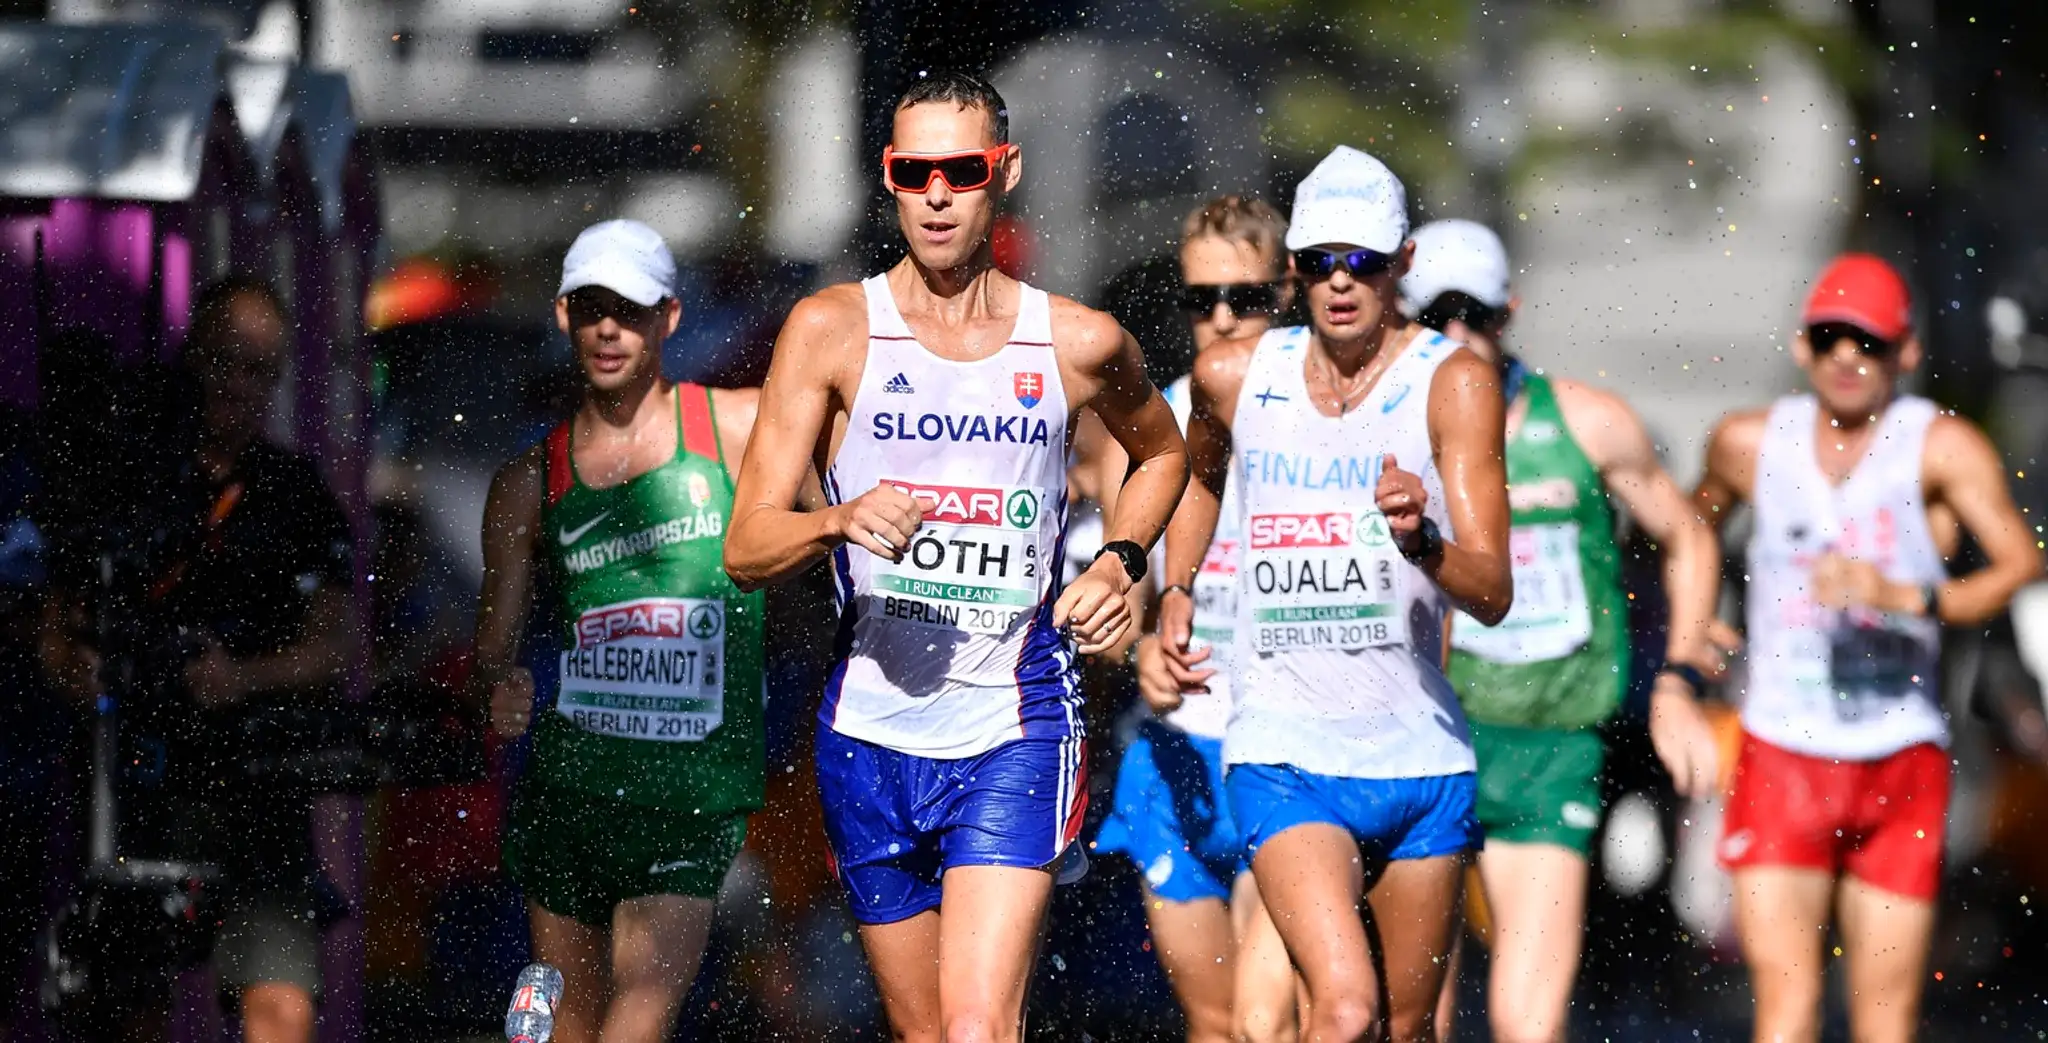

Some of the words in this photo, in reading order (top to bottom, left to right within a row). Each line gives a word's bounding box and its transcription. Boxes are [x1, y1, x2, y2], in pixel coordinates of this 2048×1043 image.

[883, 384, 915, 394] adidas
[872, 412, 1049, 446] SLOVAKIA
[894, 486, 999, 520] PAR
[564, 511, 722, 573] MAGYARORSZÁG
[1252, 514, 1352, 547] SPAR
[893, 529, 1010, 577] ÓTH
[913, 581, 942, 597] RUN
[1255, 558, 1367, 594] OJALA
[580, 606, 680, 644] SPAR
[885, 596, 960, 627] BERLIN
[967, 608, 1020, 630] 2018
[1260, 626, 1333, 647] BERLIN
[1339, 623, 1388, 644] 2018
[566, 646, 698, 686] HELEBRANDT
[573, 709, 648, 734] BERLIN
[656, 717, 708, 737] 2018
